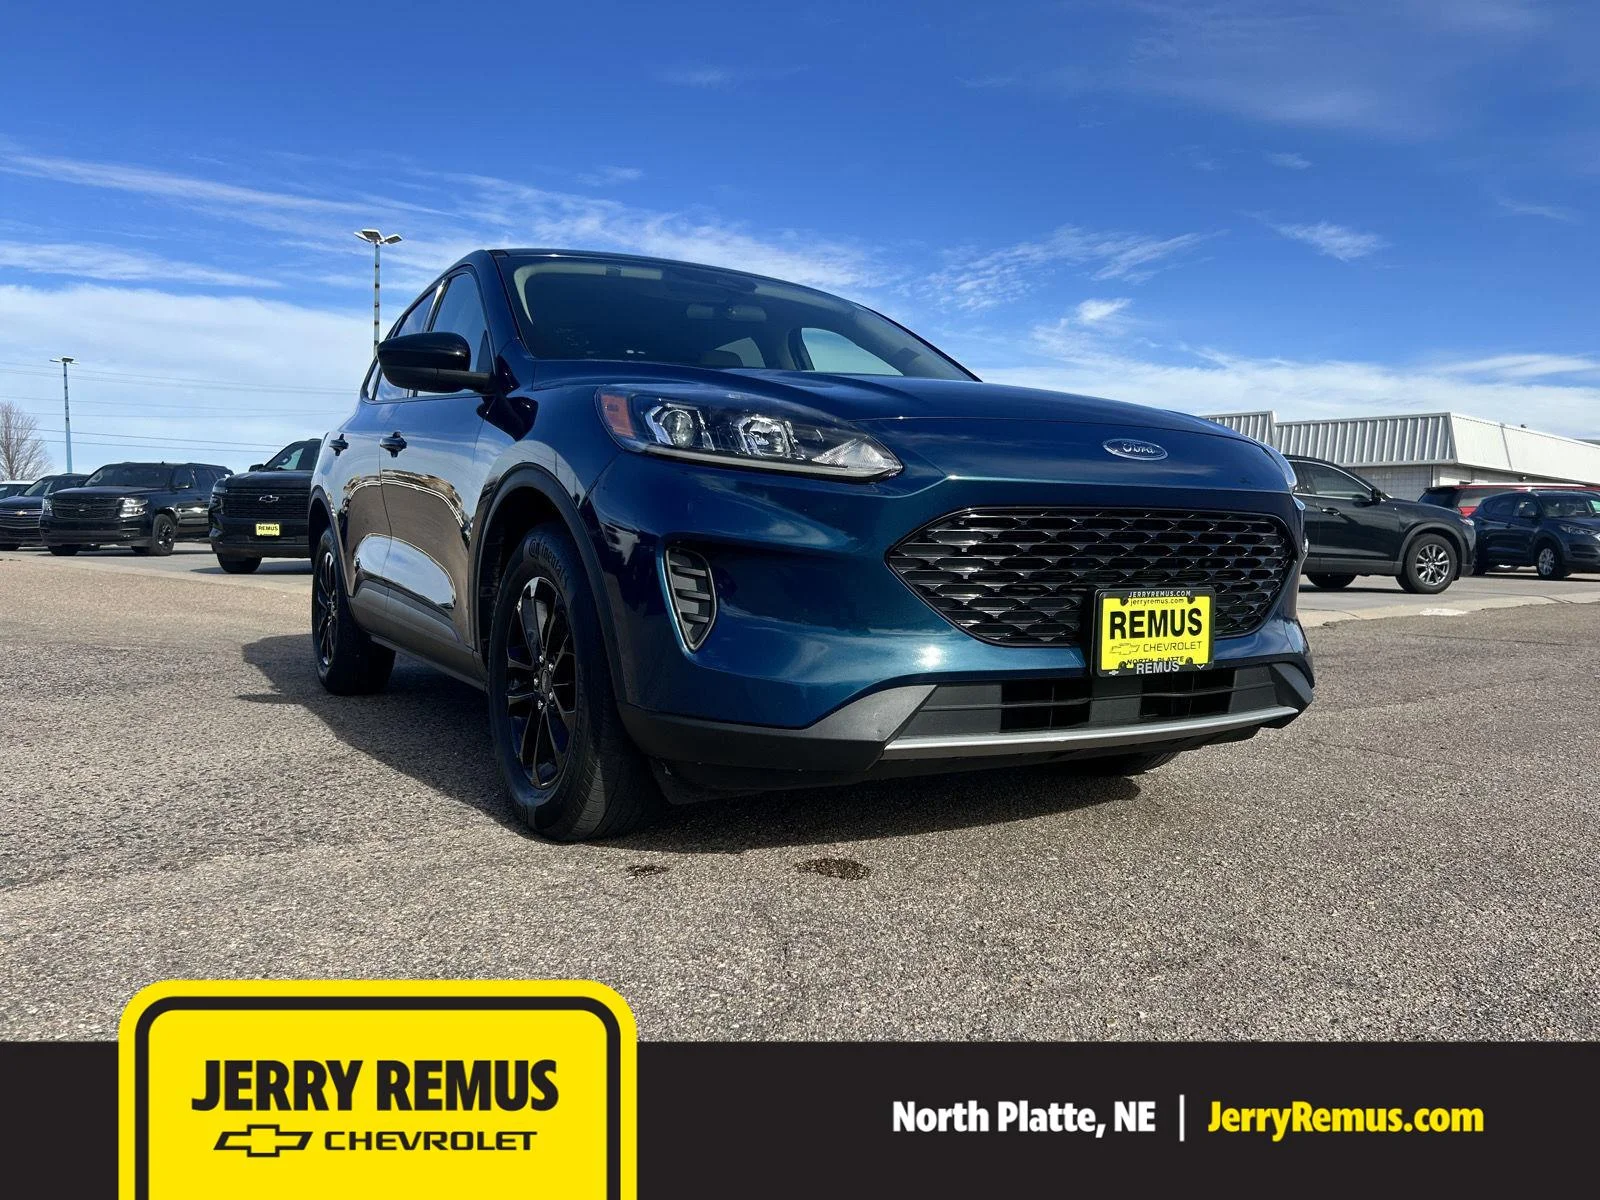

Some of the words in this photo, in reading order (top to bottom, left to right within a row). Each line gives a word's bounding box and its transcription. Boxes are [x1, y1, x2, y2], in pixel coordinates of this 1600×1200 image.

[1128, 590, 1192, 598] JERRYREMUS.COM
[1130, 598, 1185, 606] jerryremus.com
[1109, 607, 1203, 640] REMUS
[1143, 641, 1203, 653] CHEVROLET
[1136, 660, 1180, 675] REMUS
